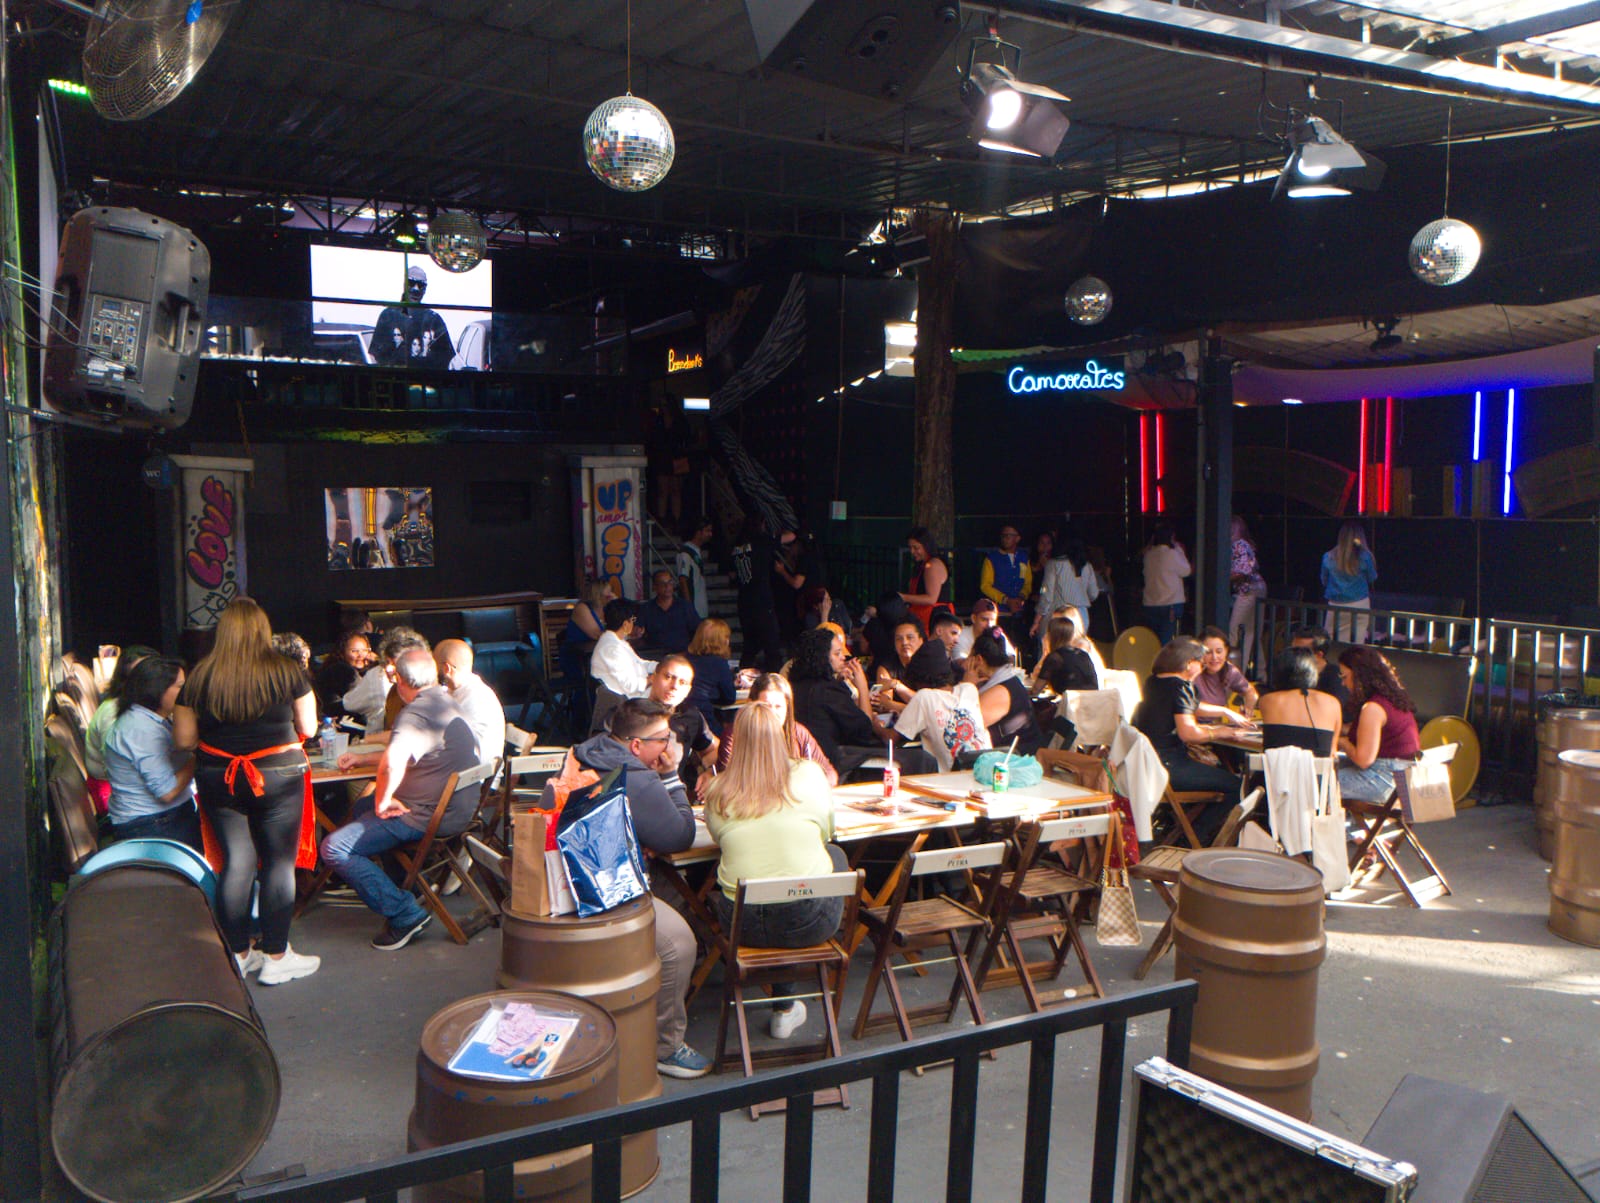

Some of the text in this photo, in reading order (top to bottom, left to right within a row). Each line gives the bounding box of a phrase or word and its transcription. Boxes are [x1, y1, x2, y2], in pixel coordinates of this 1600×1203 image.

[145, 470, 161, 478] WC
[594, 479, 633, 513] UP
[186, 474, 235, 590] LOVE
[947, 859, 969, 867] PETRA
[787, 888, 814, 896] PETRA
